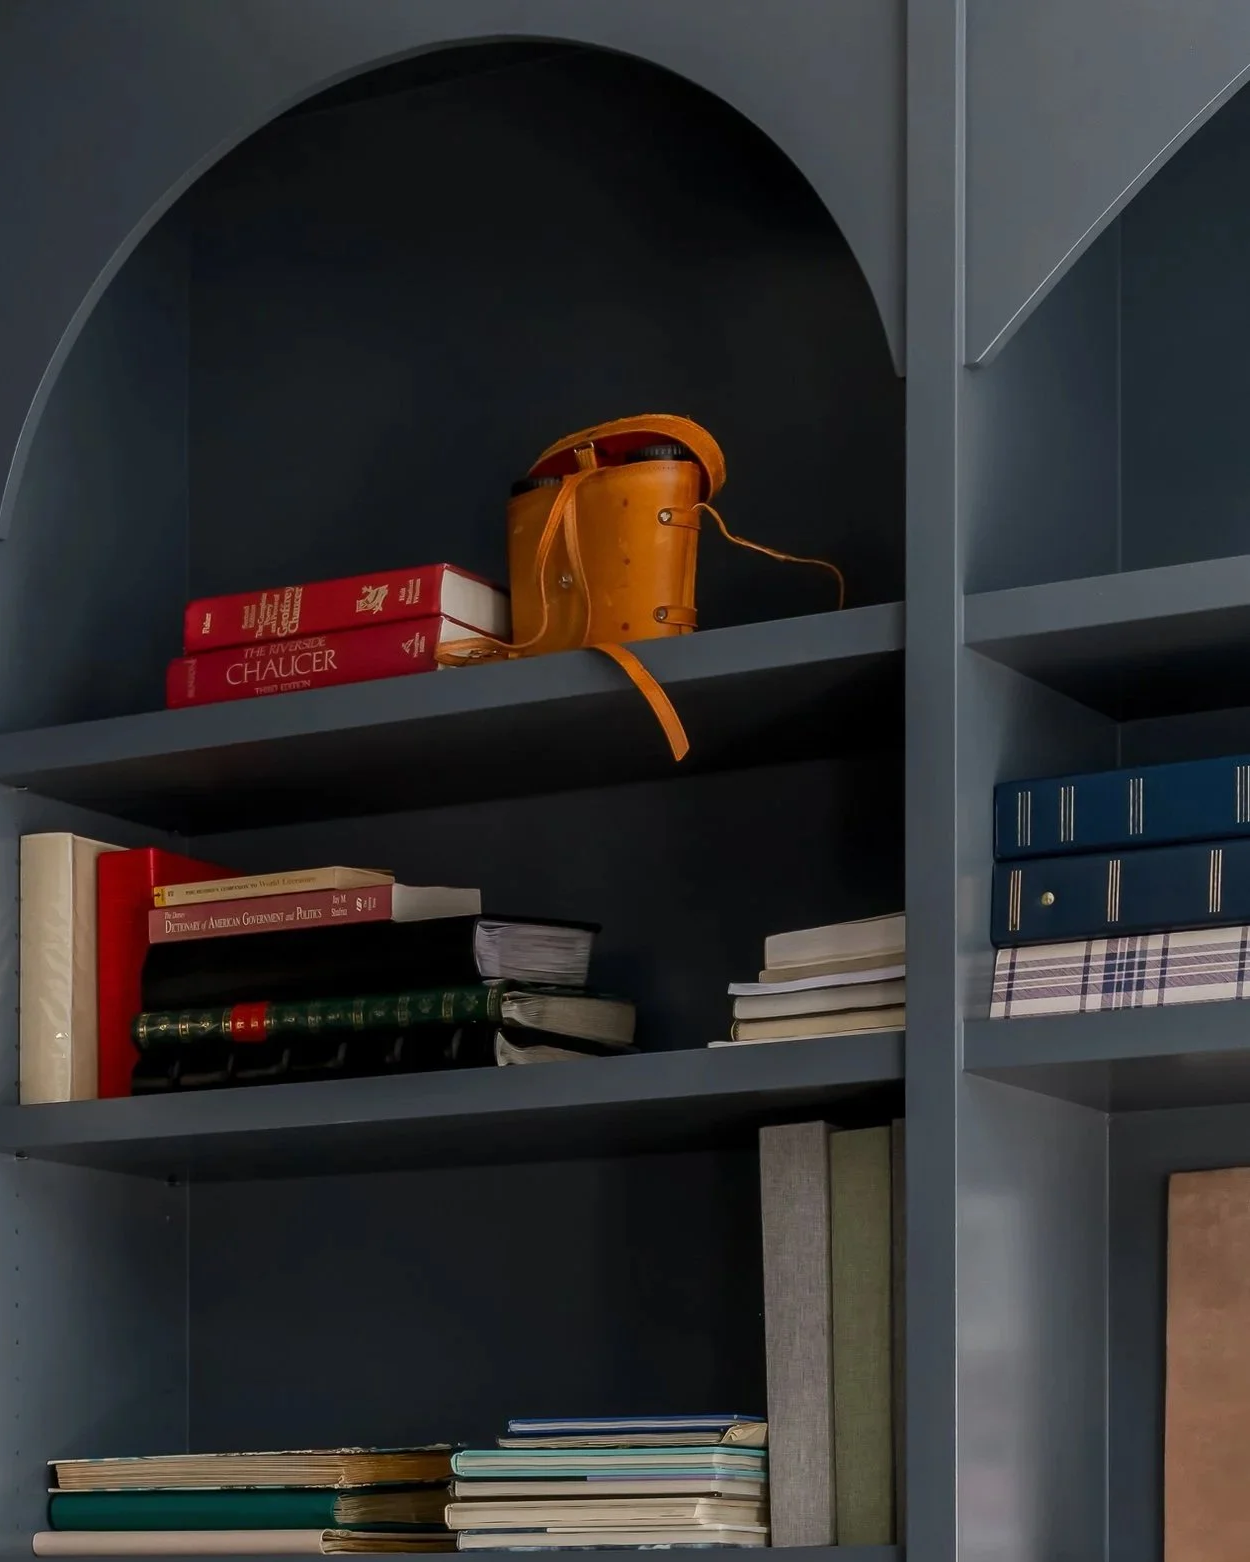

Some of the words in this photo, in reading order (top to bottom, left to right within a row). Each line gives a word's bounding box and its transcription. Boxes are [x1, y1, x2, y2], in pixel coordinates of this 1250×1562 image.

[277, 586, 294, 637] Geoffrey
[288, 587, 303, 634] Chaucer
[244, 645, 266, 659] THE
[269, 636, 326, 656] RIVERSIDE
[226, 649, 337, 685] CHAUCER
[255, 685, 278, 695] THIRD
[280, 679, 311, 691] EDITION
[209, 917, 241, 929] AMERICAN
[242, 912, 284, 926] GOVERNMENT
